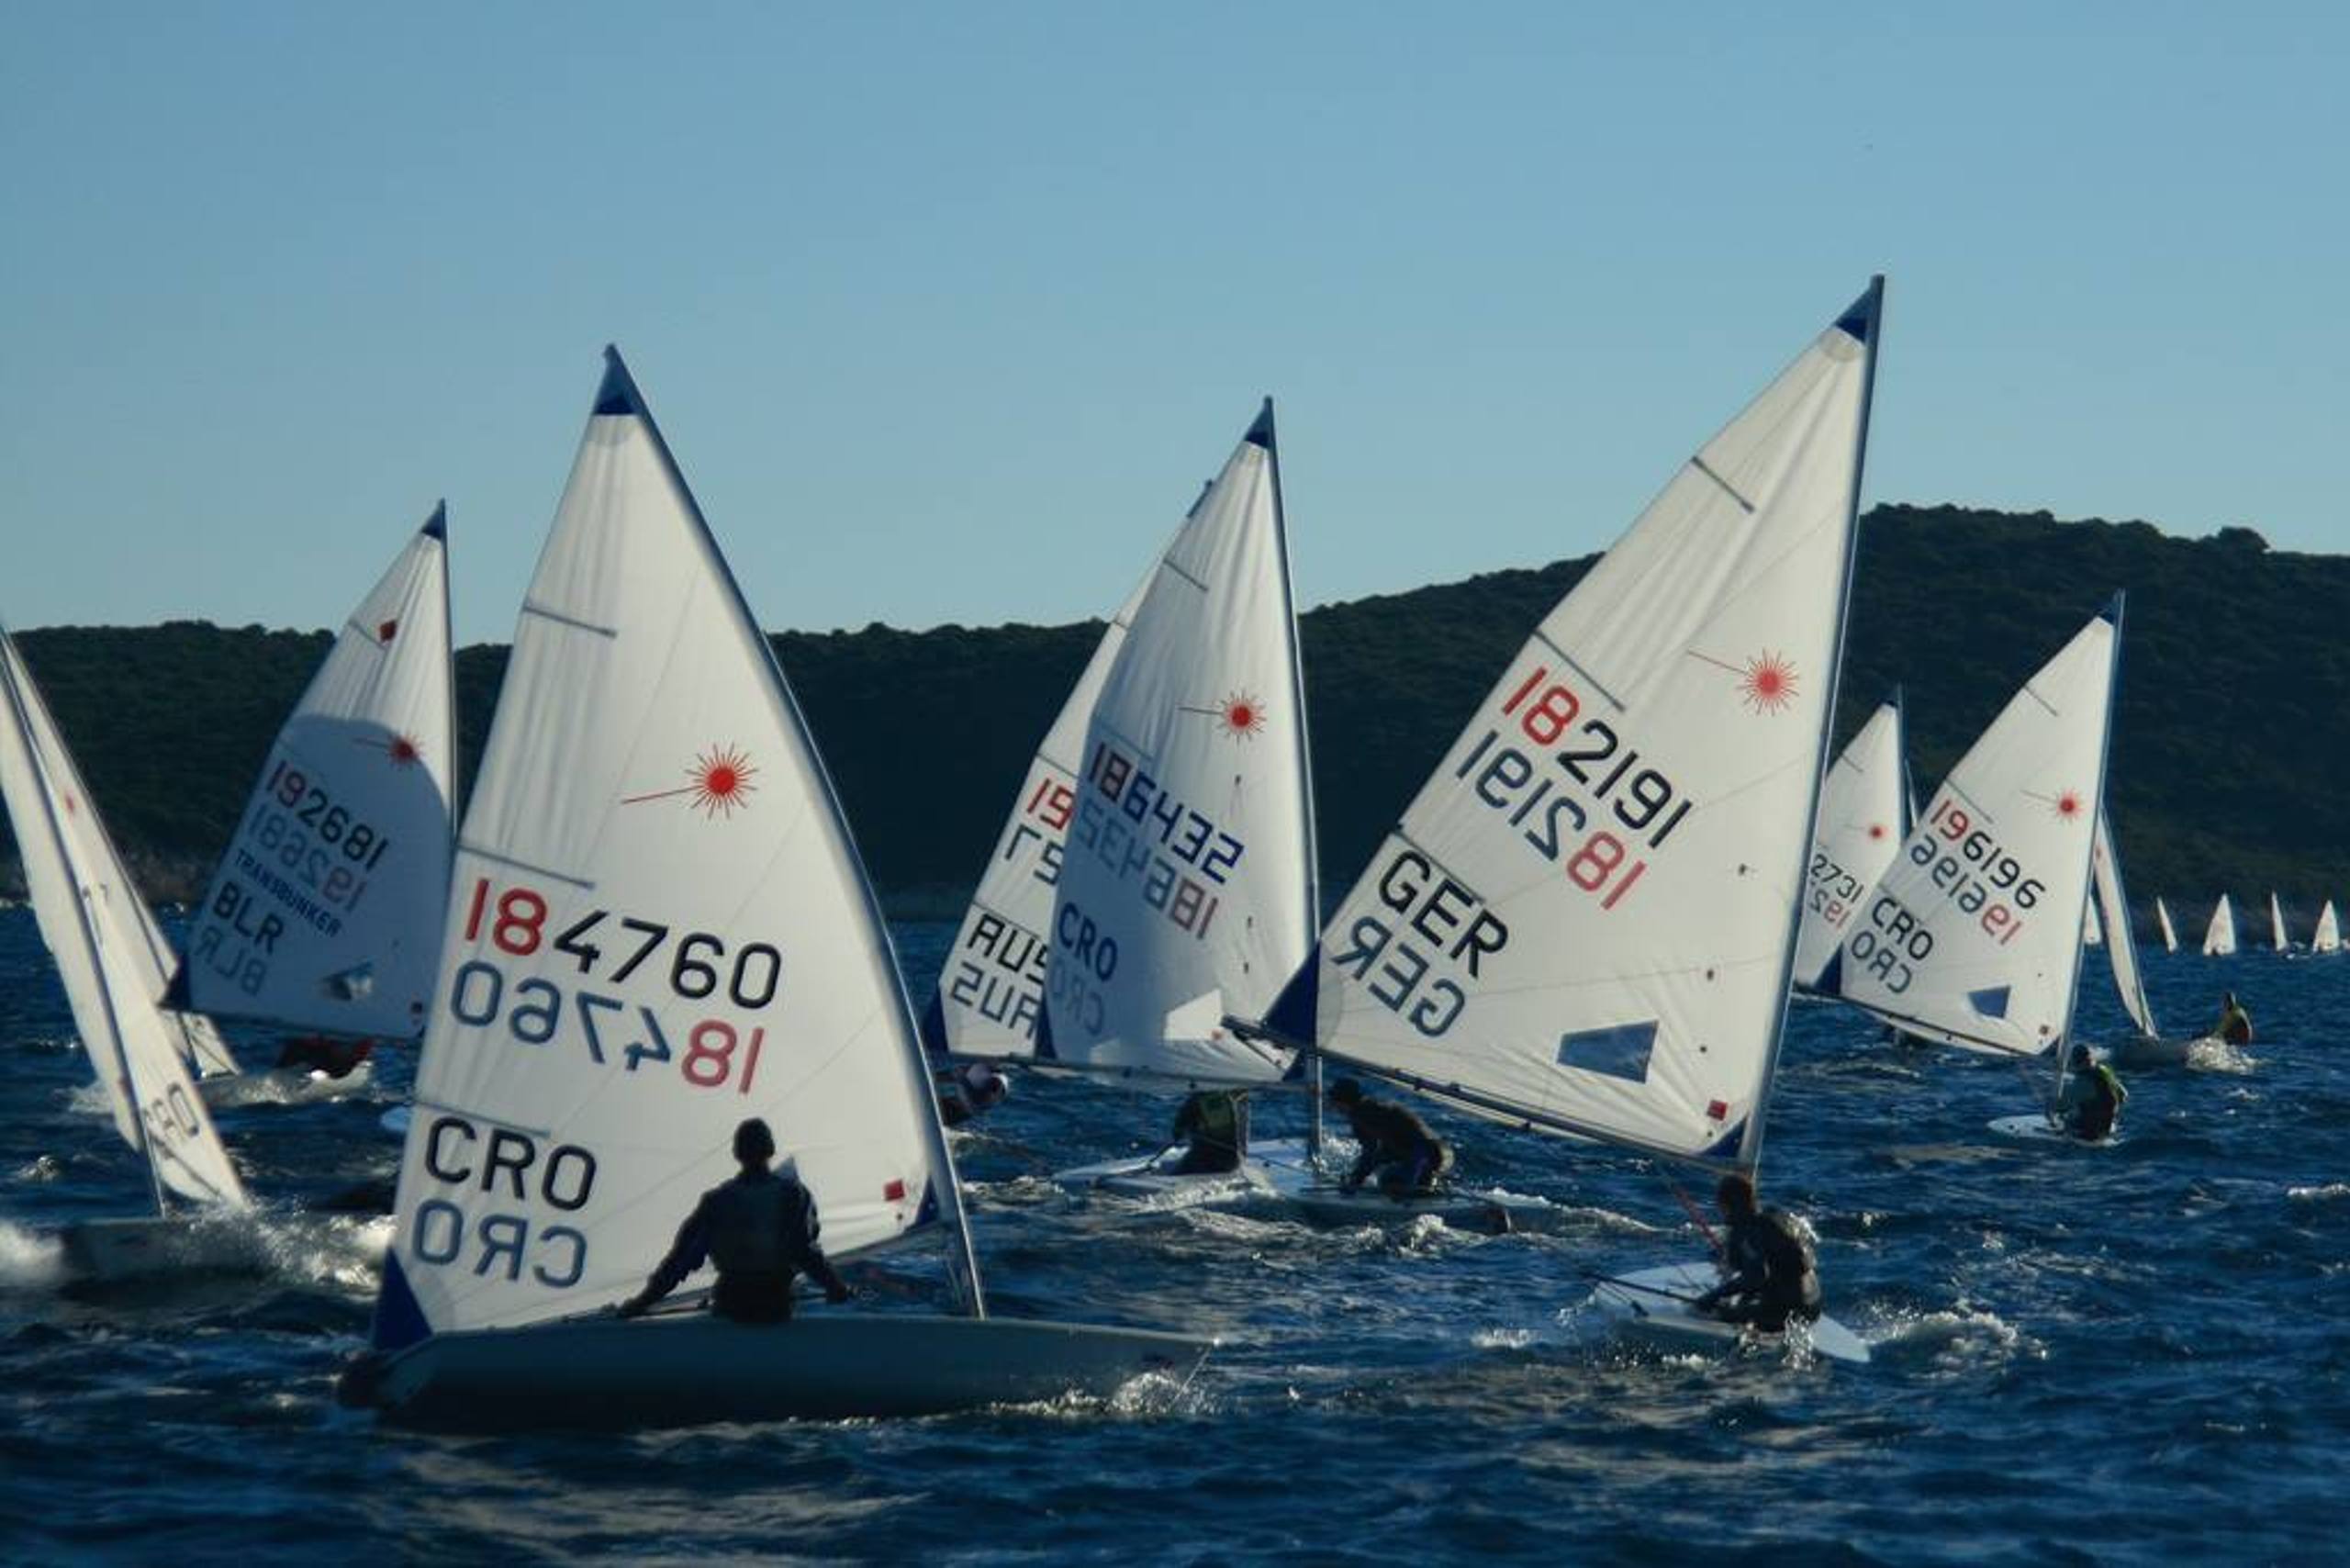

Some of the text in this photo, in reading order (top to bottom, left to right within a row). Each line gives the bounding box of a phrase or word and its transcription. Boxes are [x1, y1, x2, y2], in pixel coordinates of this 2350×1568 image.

[1502, 666, 1693, 849] 182191
[267, 760, 389, 872] 192681
[1090, 743, 1245, 884] 186432
[1930, 800, 2046, 910] 196196
[212, 881, 284, 953] BLR
[1378, 851, 1508, 979] GER
[1810, 854, 1864, 903] 2731
[1873, 897, 1933, 961] CRO
[464, 879, 781, 1010] 184760
[1058, 902, 1118, 982] CRO
[425, 1117, 597, 1211] CRO
